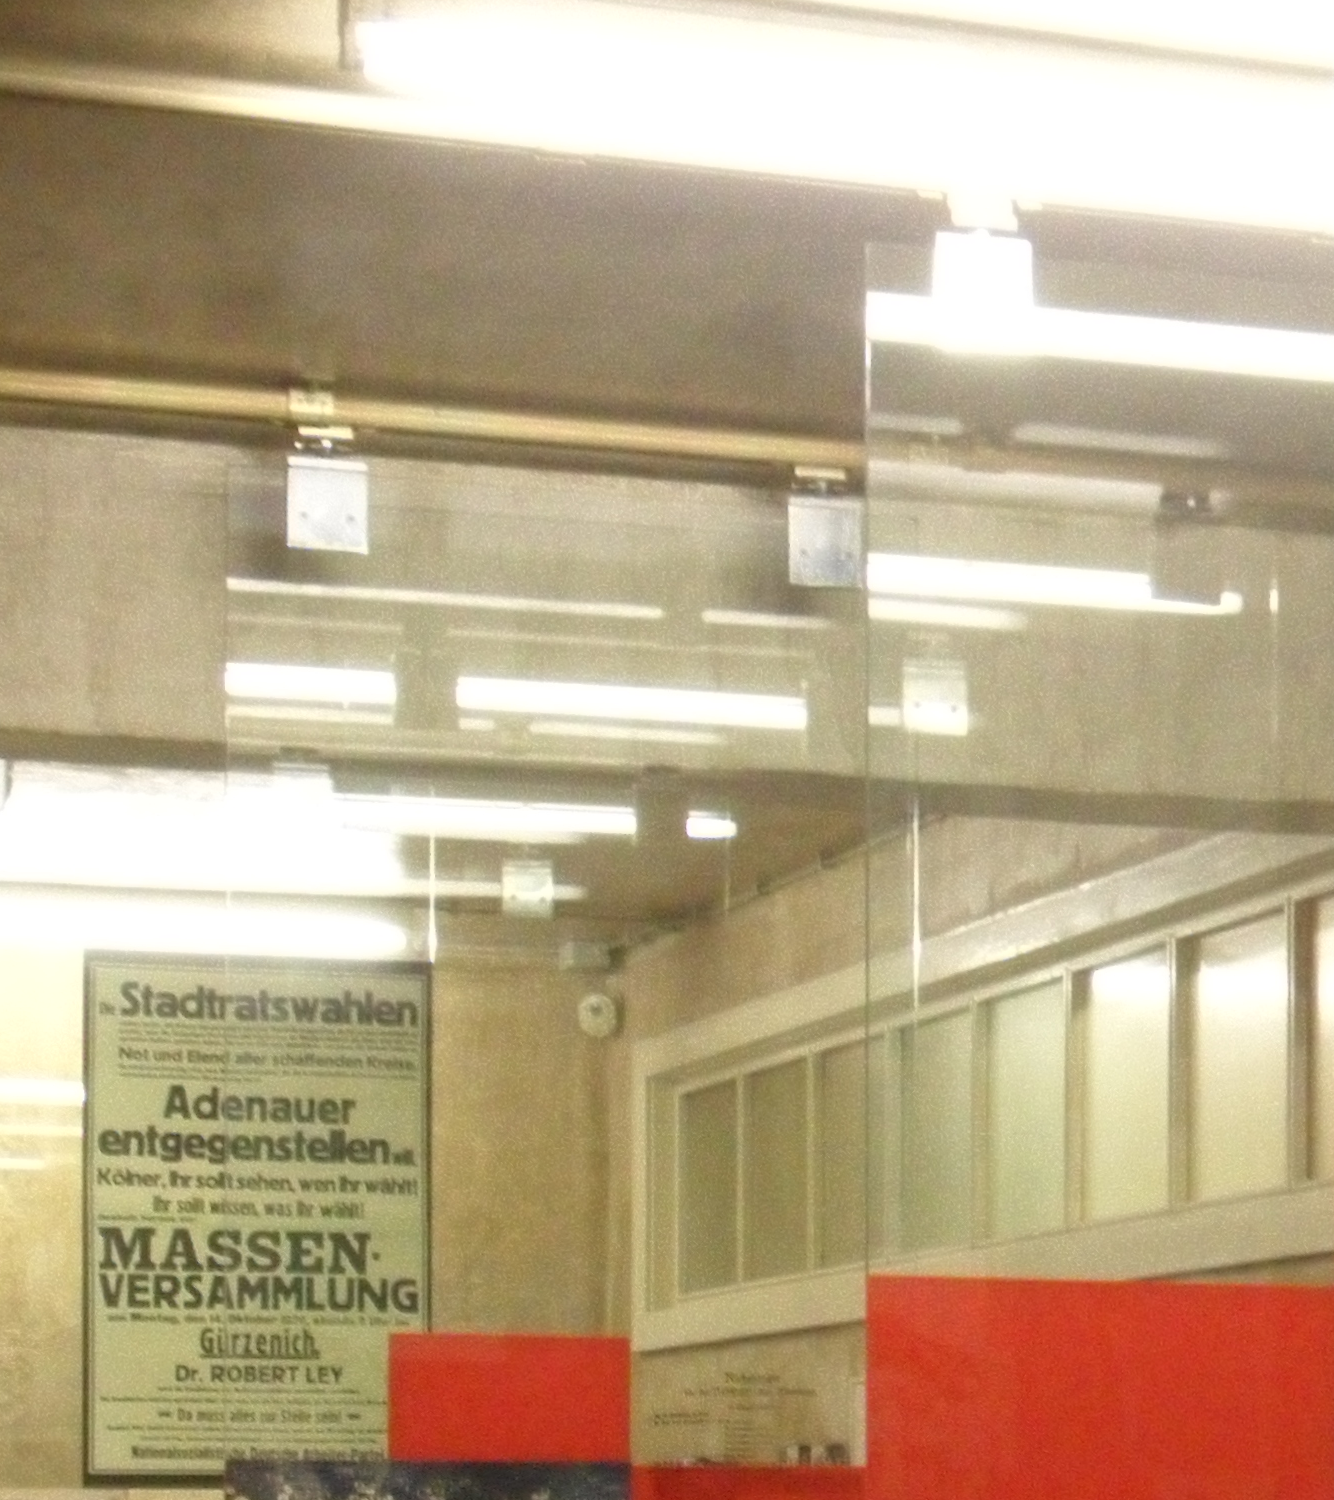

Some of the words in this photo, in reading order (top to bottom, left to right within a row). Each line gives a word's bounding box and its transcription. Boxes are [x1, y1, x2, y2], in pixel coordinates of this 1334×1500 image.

[120, 981, 418, 1028] Stadtratswahlen
[163, 1084, 357, 1125] Adenauer
[97, 1124, 392, 1166] entgegenstellen
[98, 1271, 420, 1316] VERSAMMLUNG
[175, 1365, 204, 1384] Dr.
[210, 1365, 300, 1385] ROBERT
[305, 1366, 344, 1385] LEY
